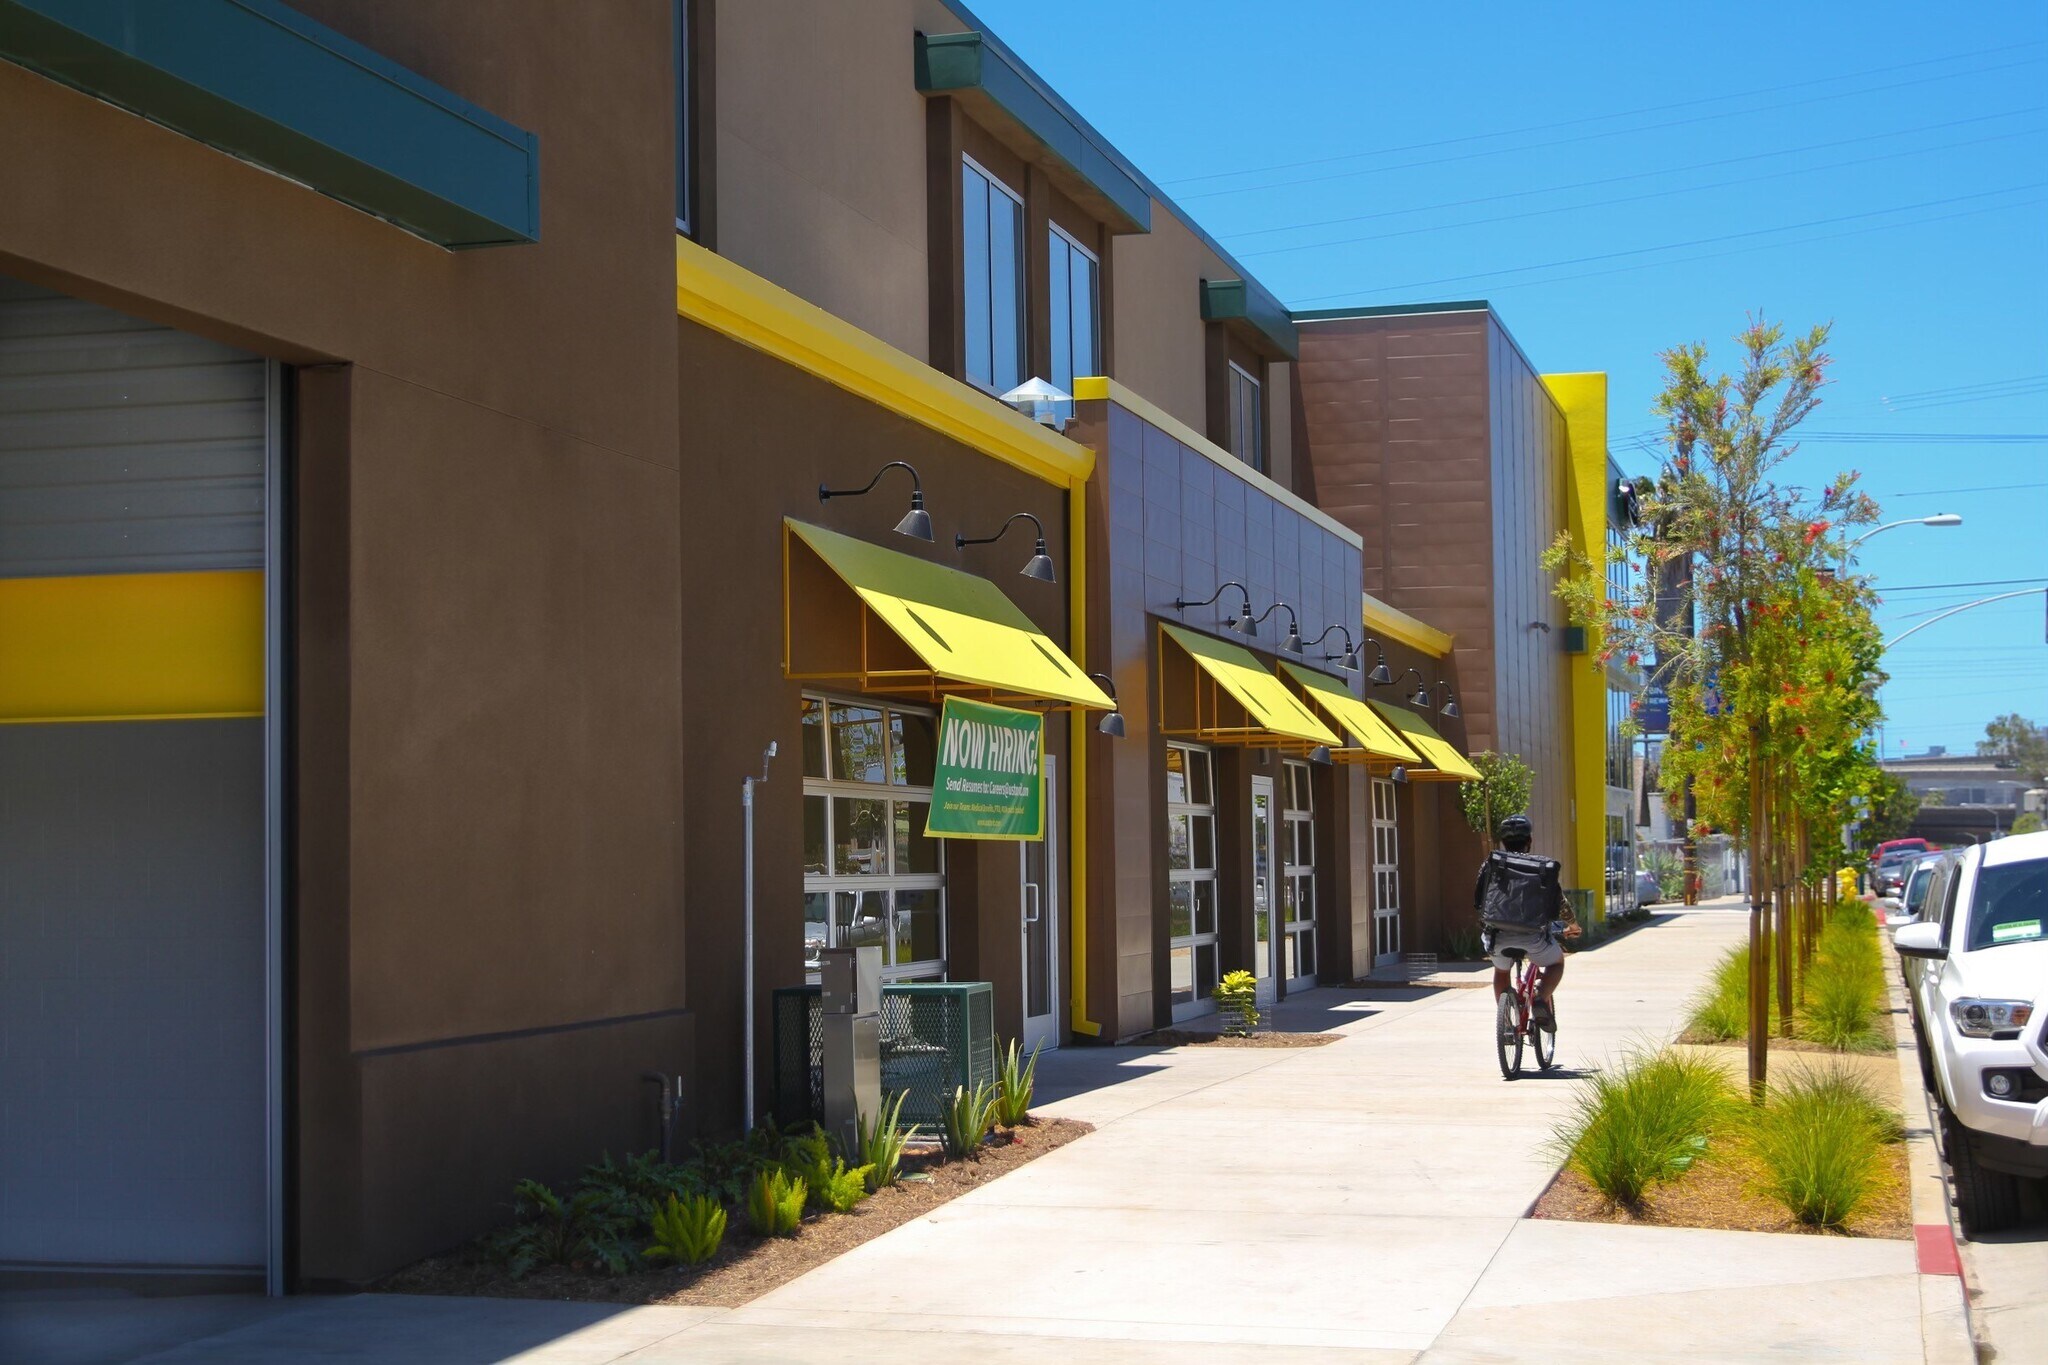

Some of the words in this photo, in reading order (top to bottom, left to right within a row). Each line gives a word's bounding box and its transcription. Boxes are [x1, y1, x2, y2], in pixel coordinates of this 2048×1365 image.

[942, 718, 985, 769] NOW
[987, 724, 1039, 775] HIRING!
[946, 777, 962, 791] Send
[962, 779, 982, 794] Resumes
